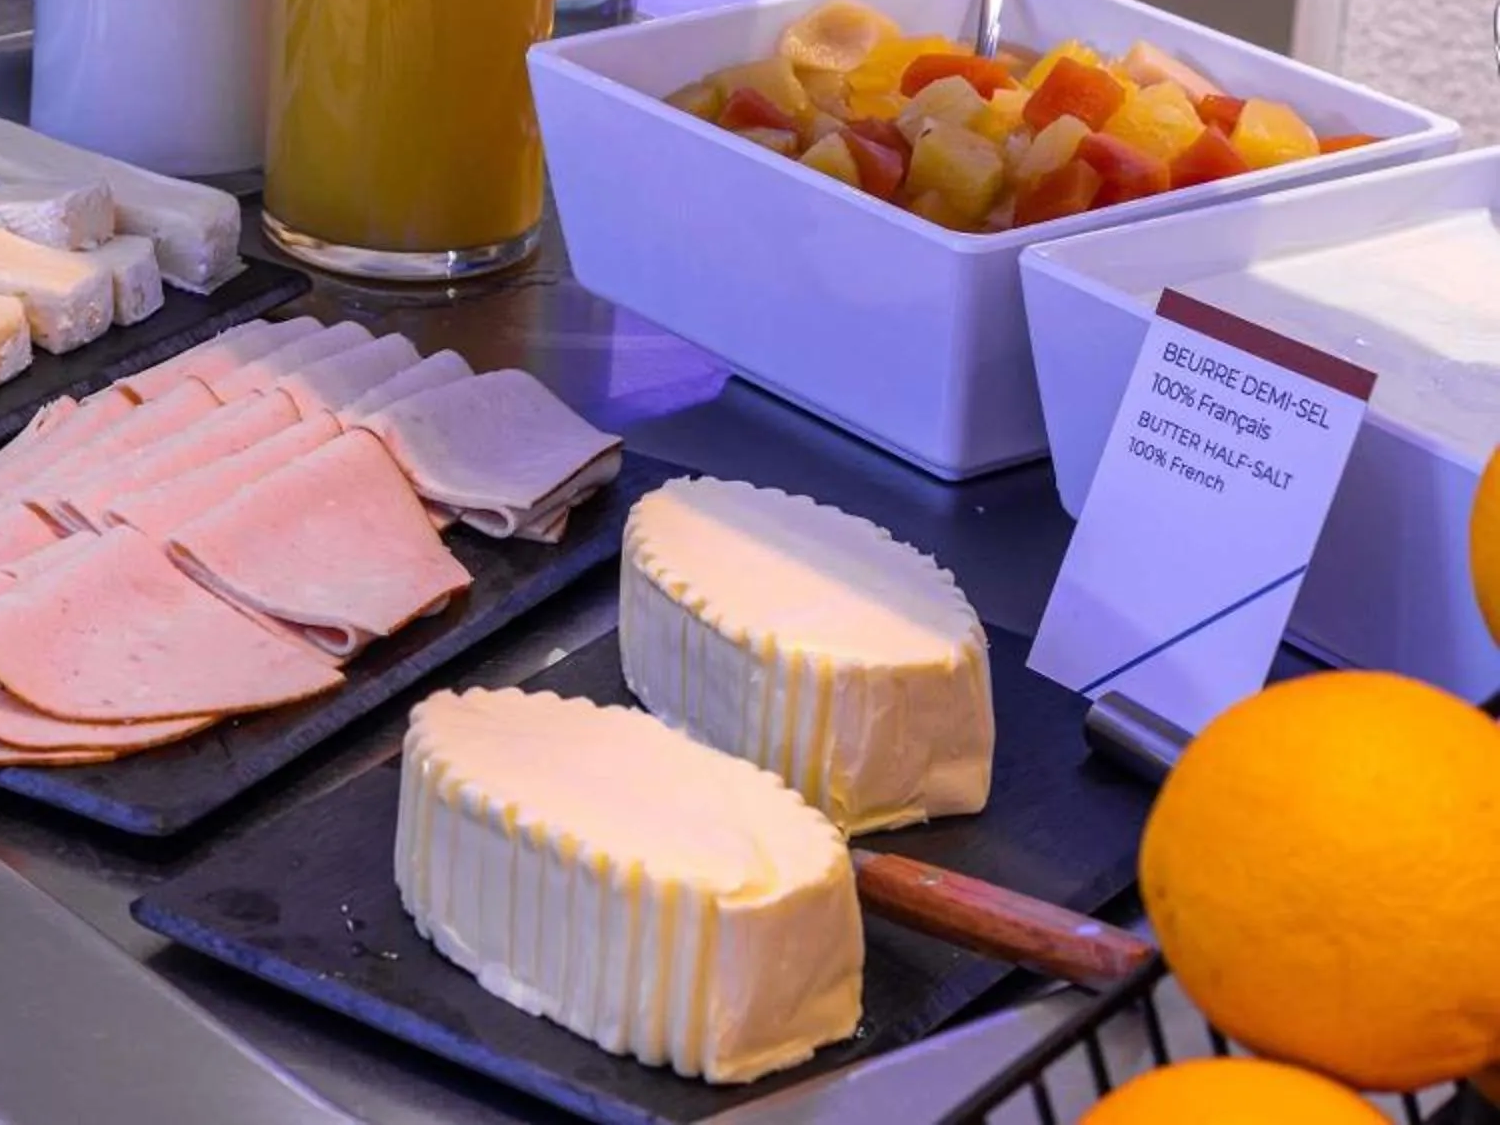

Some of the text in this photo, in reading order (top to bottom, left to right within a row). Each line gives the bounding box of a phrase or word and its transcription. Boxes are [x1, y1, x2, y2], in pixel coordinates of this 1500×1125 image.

[1151, 372, 1272, 441] 100% Français
[1162, 341, 1330, 430] BEURRE DEMI-SEL
[1127, 435, 1226, 493] 100% French
[1137, 410, 1294, 490] BUTTER HALF-SALT
